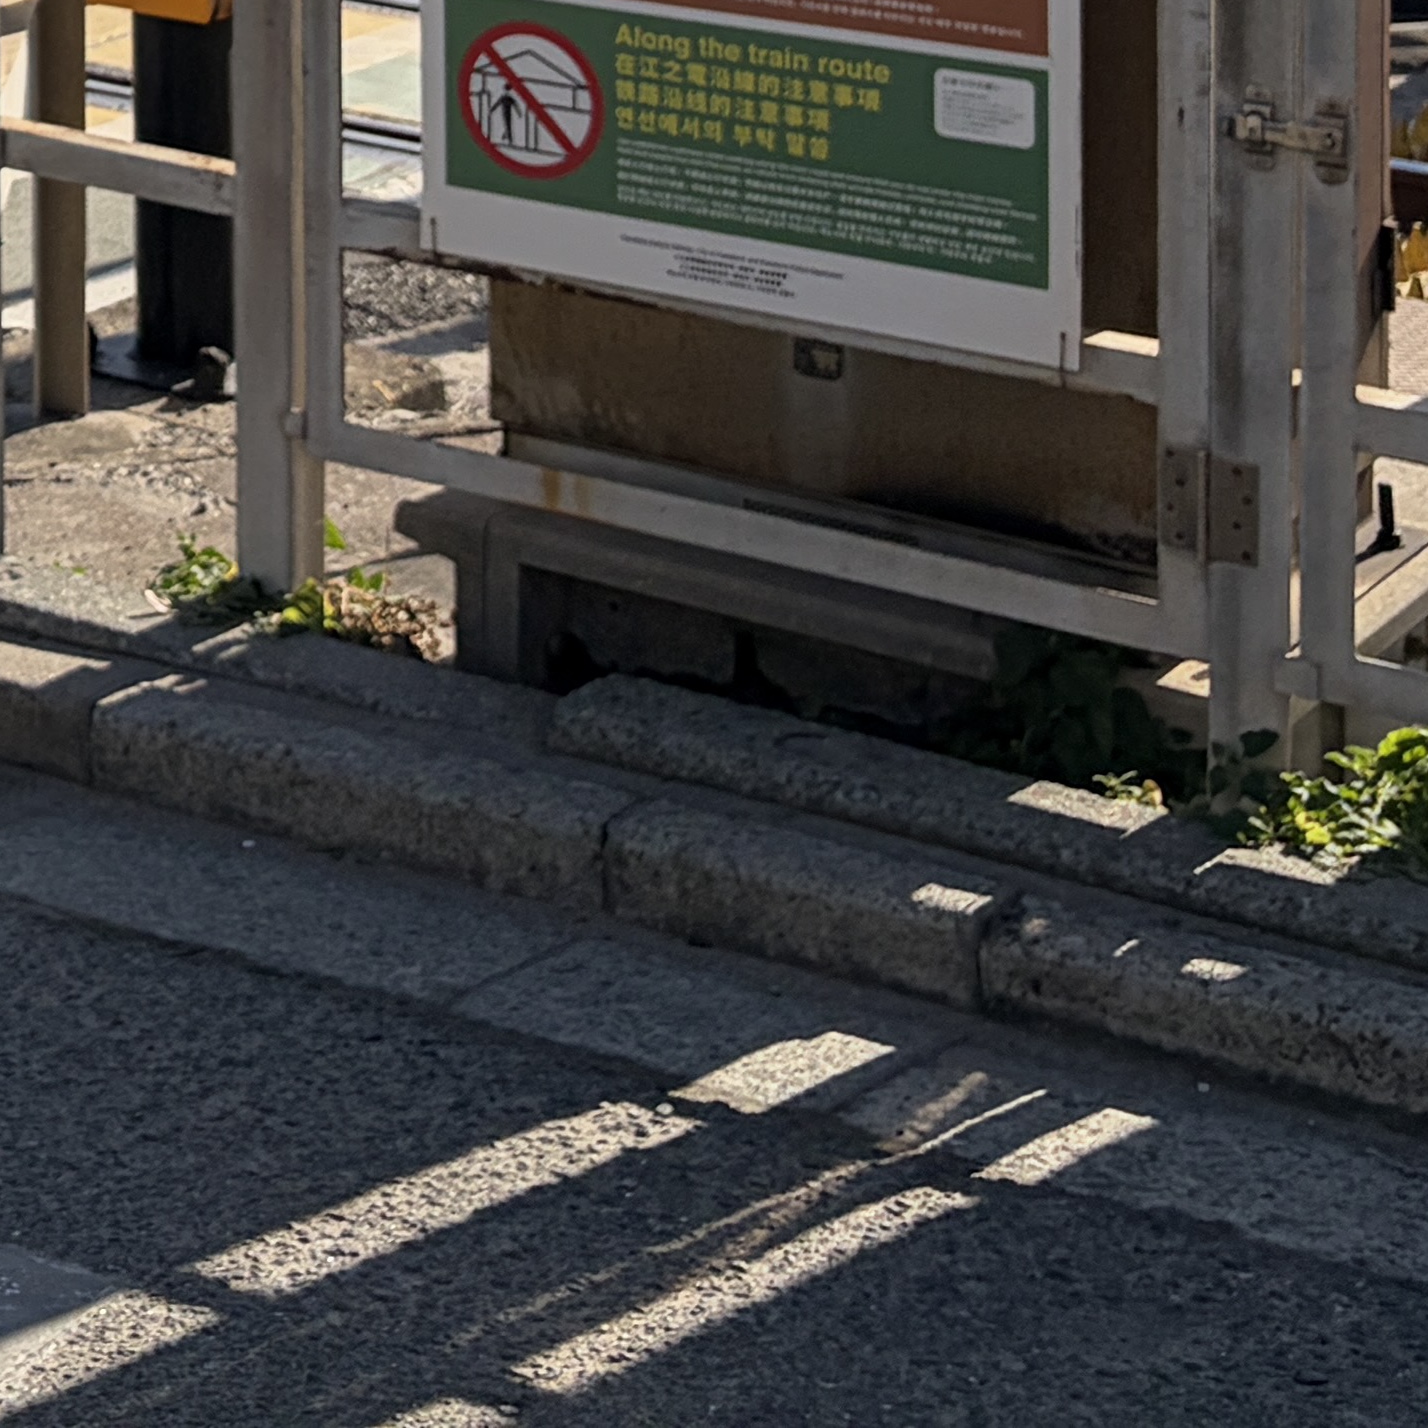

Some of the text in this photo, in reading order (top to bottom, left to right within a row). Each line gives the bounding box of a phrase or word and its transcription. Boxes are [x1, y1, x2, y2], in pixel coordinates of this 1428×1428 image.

[615, 23, 892, 84] Along the train route
